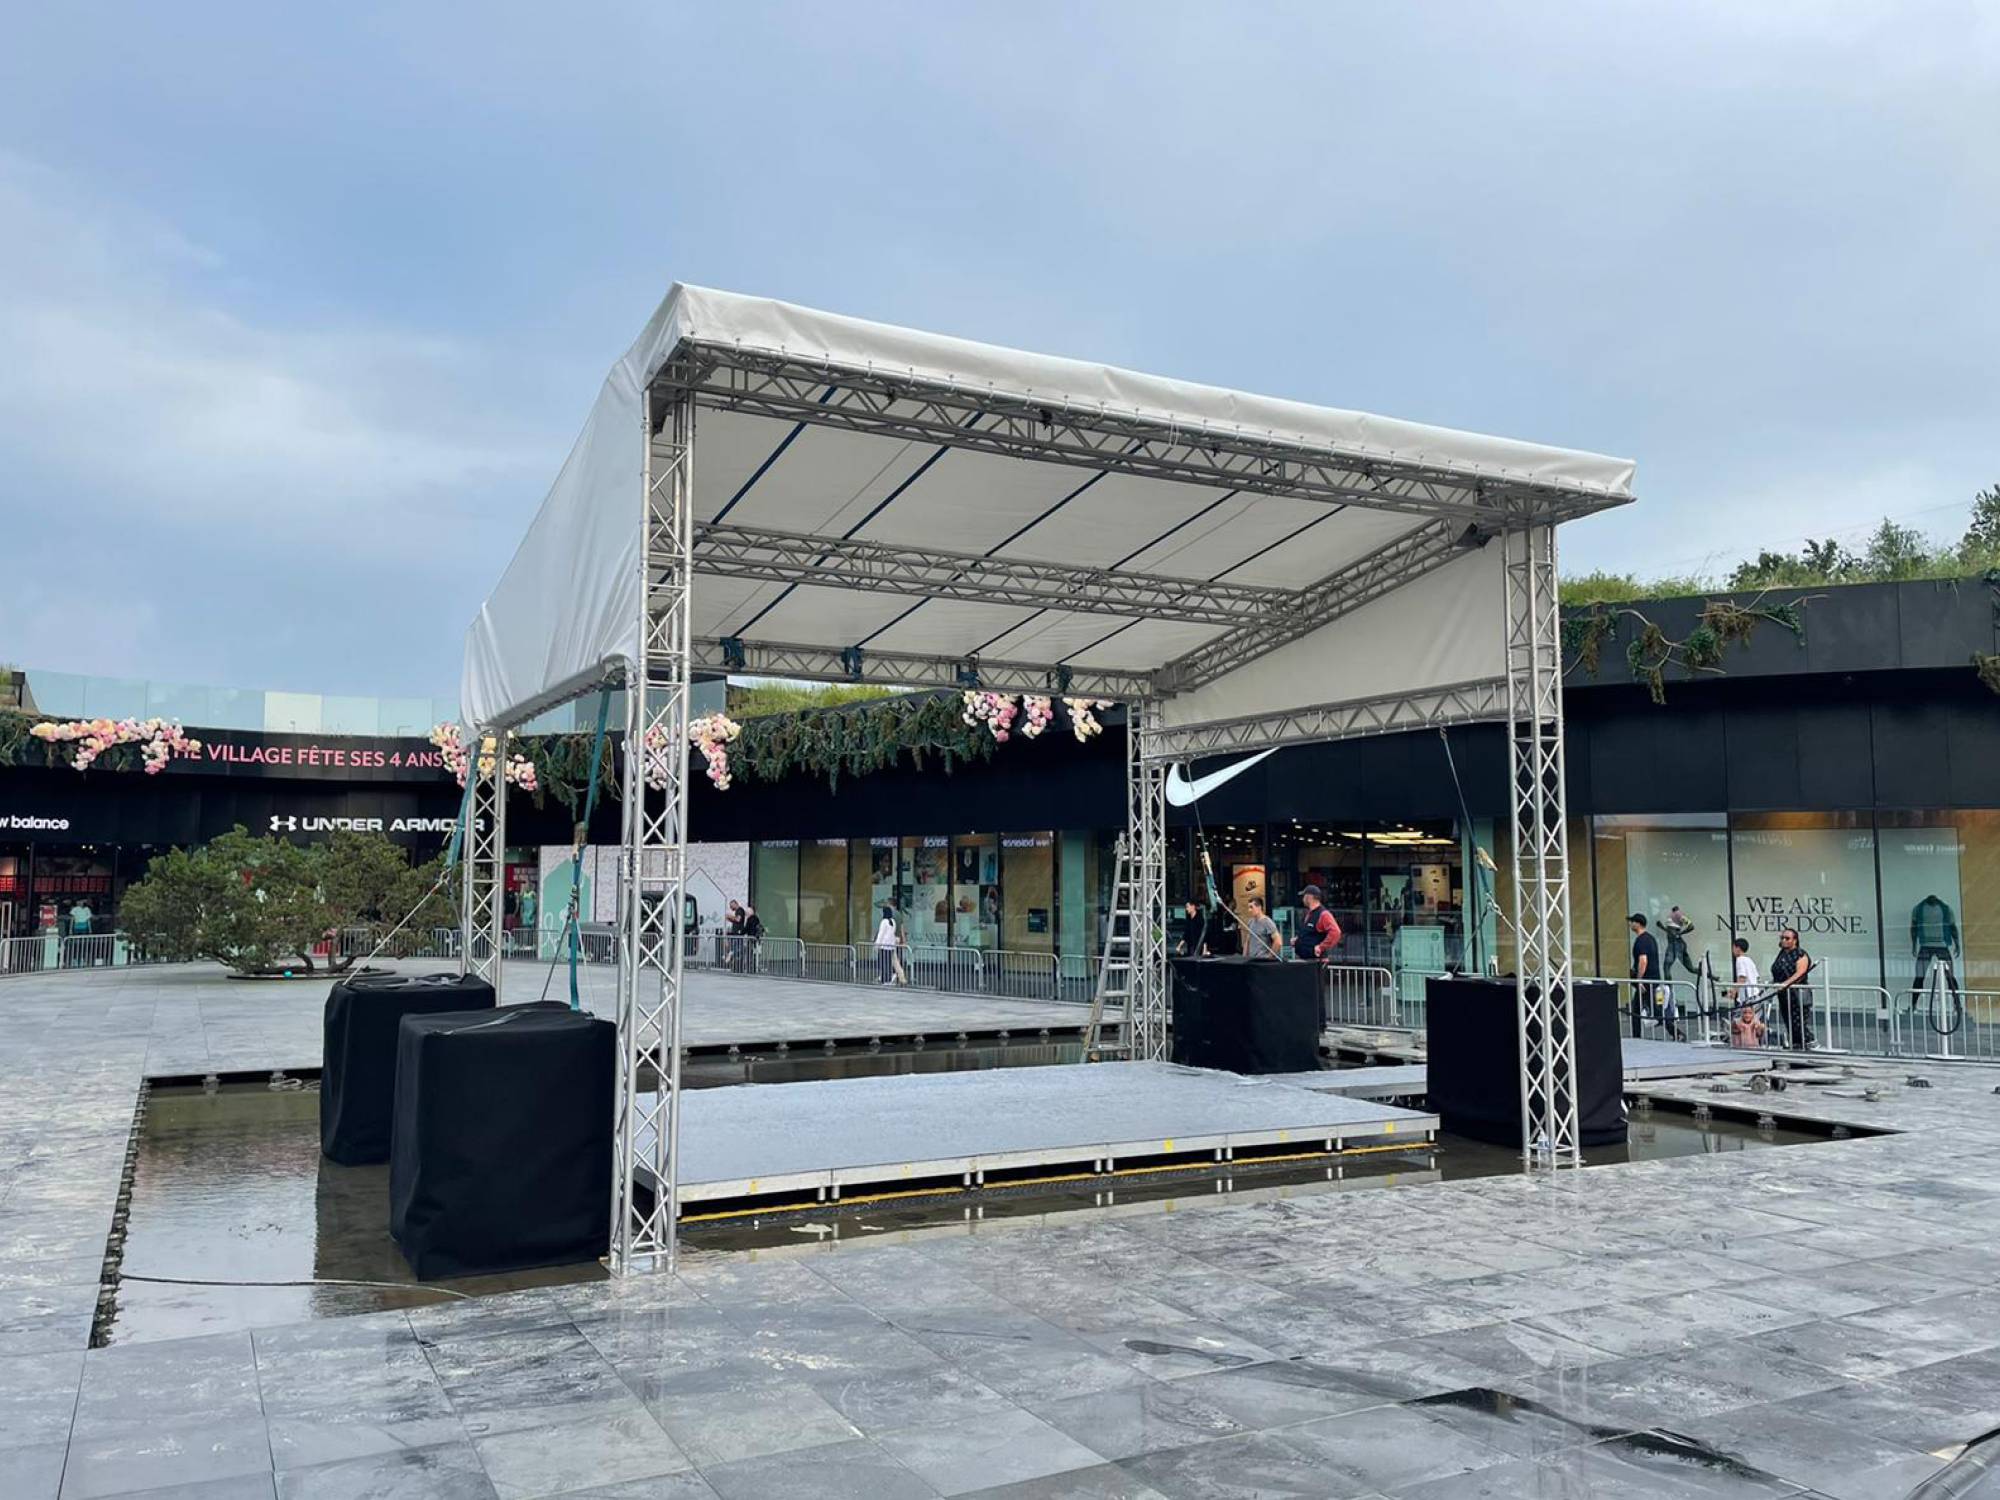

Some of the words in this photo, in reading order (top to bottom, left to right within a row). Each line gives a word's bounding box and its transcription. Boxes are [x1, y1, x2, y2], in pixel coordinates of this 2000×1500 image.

[207, 743, 292, 764] VILLAGE
[297, 745, 345, 766] FÊTE
[350, 750, 385, 767] SES
[389, 751, 401, 767] 4
[405, 751, 443, 767] ANS
[11, 814, 70, 830] balance
[302, 817, 382, 832] UNDER
[389, 817, 485, 832] ARMOR
[1746, 896, 1784, 915] WE
[1788, 897, 1833, 915] ARE
[1716, 914, 1790, 932] NEVER
[1797, 915, 1868, 935] DONE.
